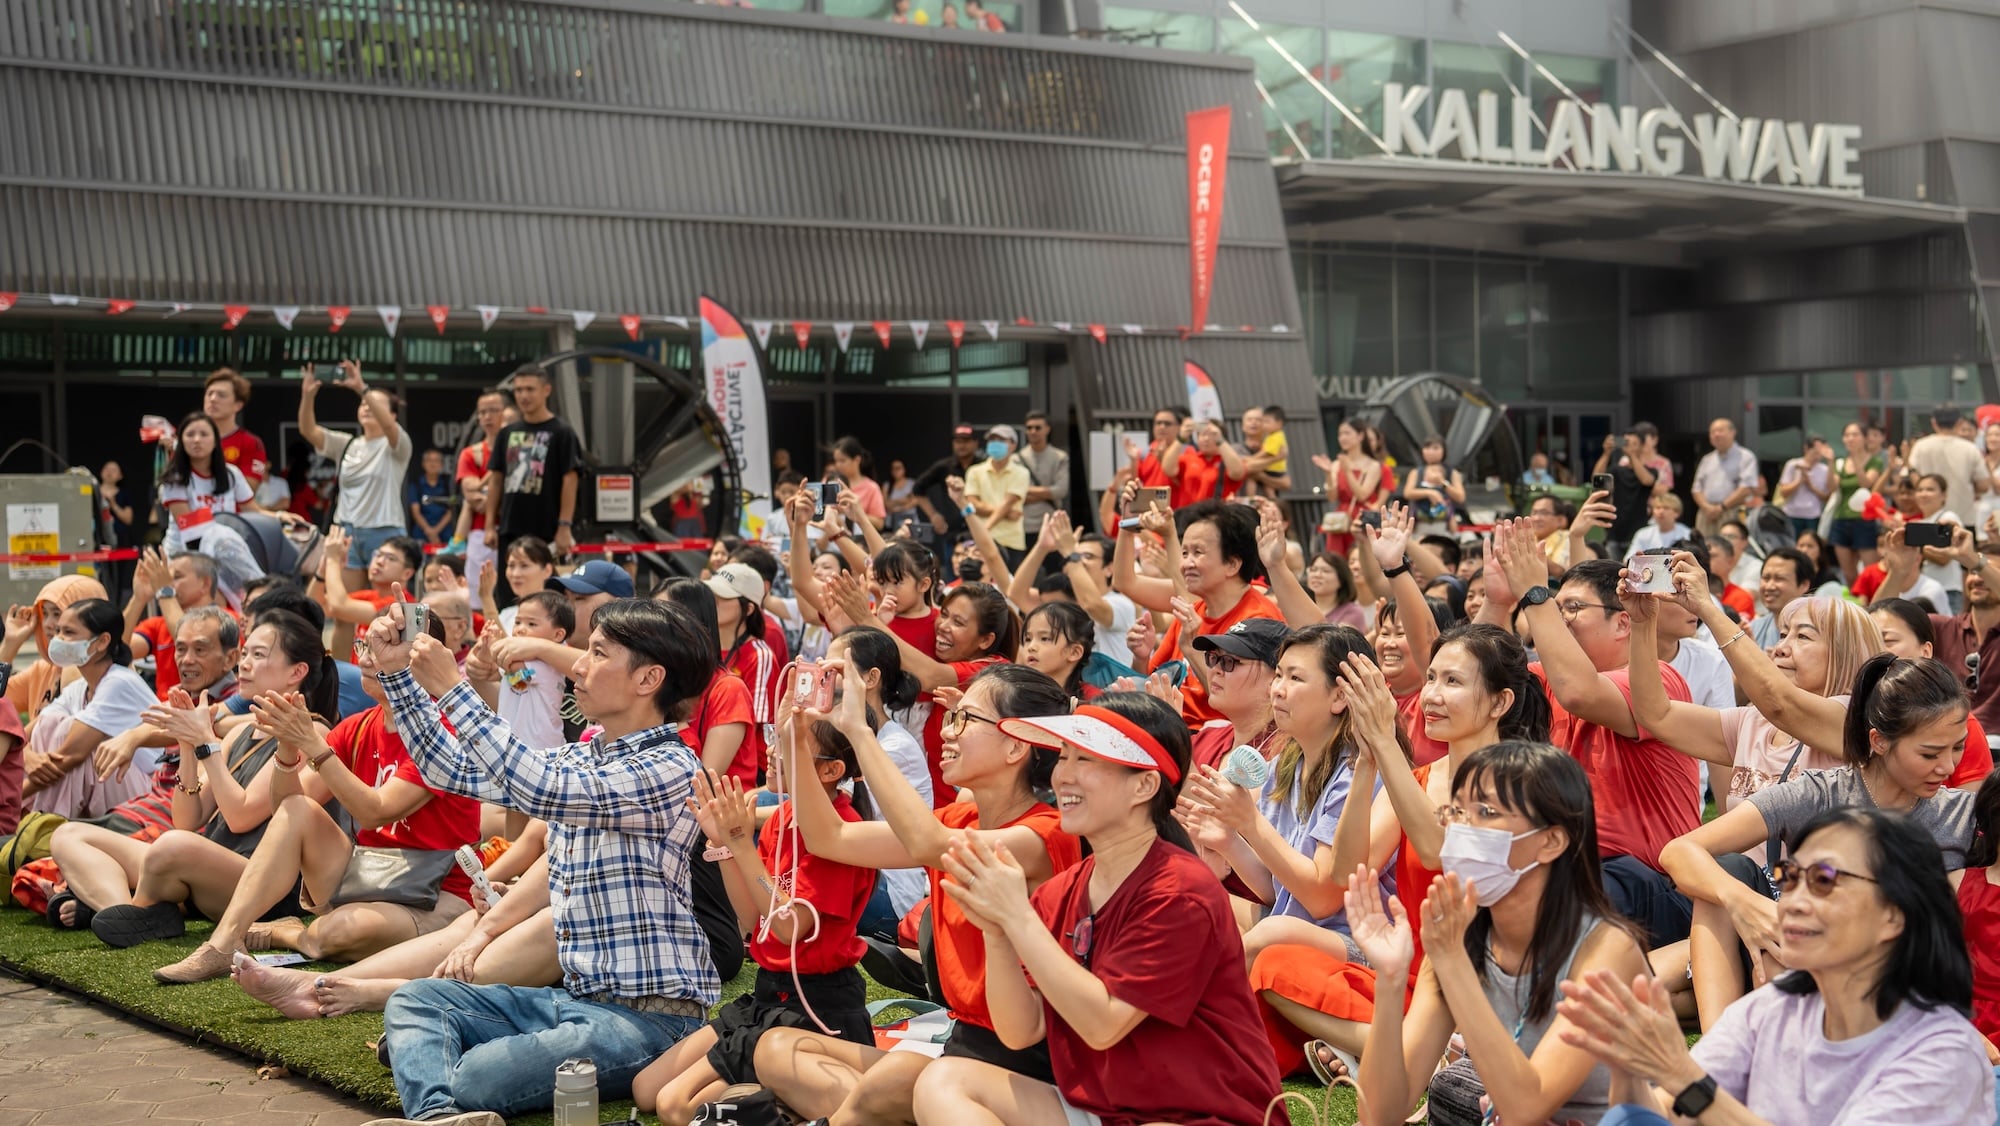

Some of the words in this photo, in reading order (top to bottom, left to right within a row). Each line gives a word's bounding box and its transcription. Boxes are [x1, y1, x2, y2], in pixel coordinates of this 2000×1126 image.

[1383, 82, 1684, 175] KALLANG
[1693, 112, 1863, 188] WAVE
[1196, 143, 1214, 214] OCBC
[1312, 375, 1396, 400] KALLA
